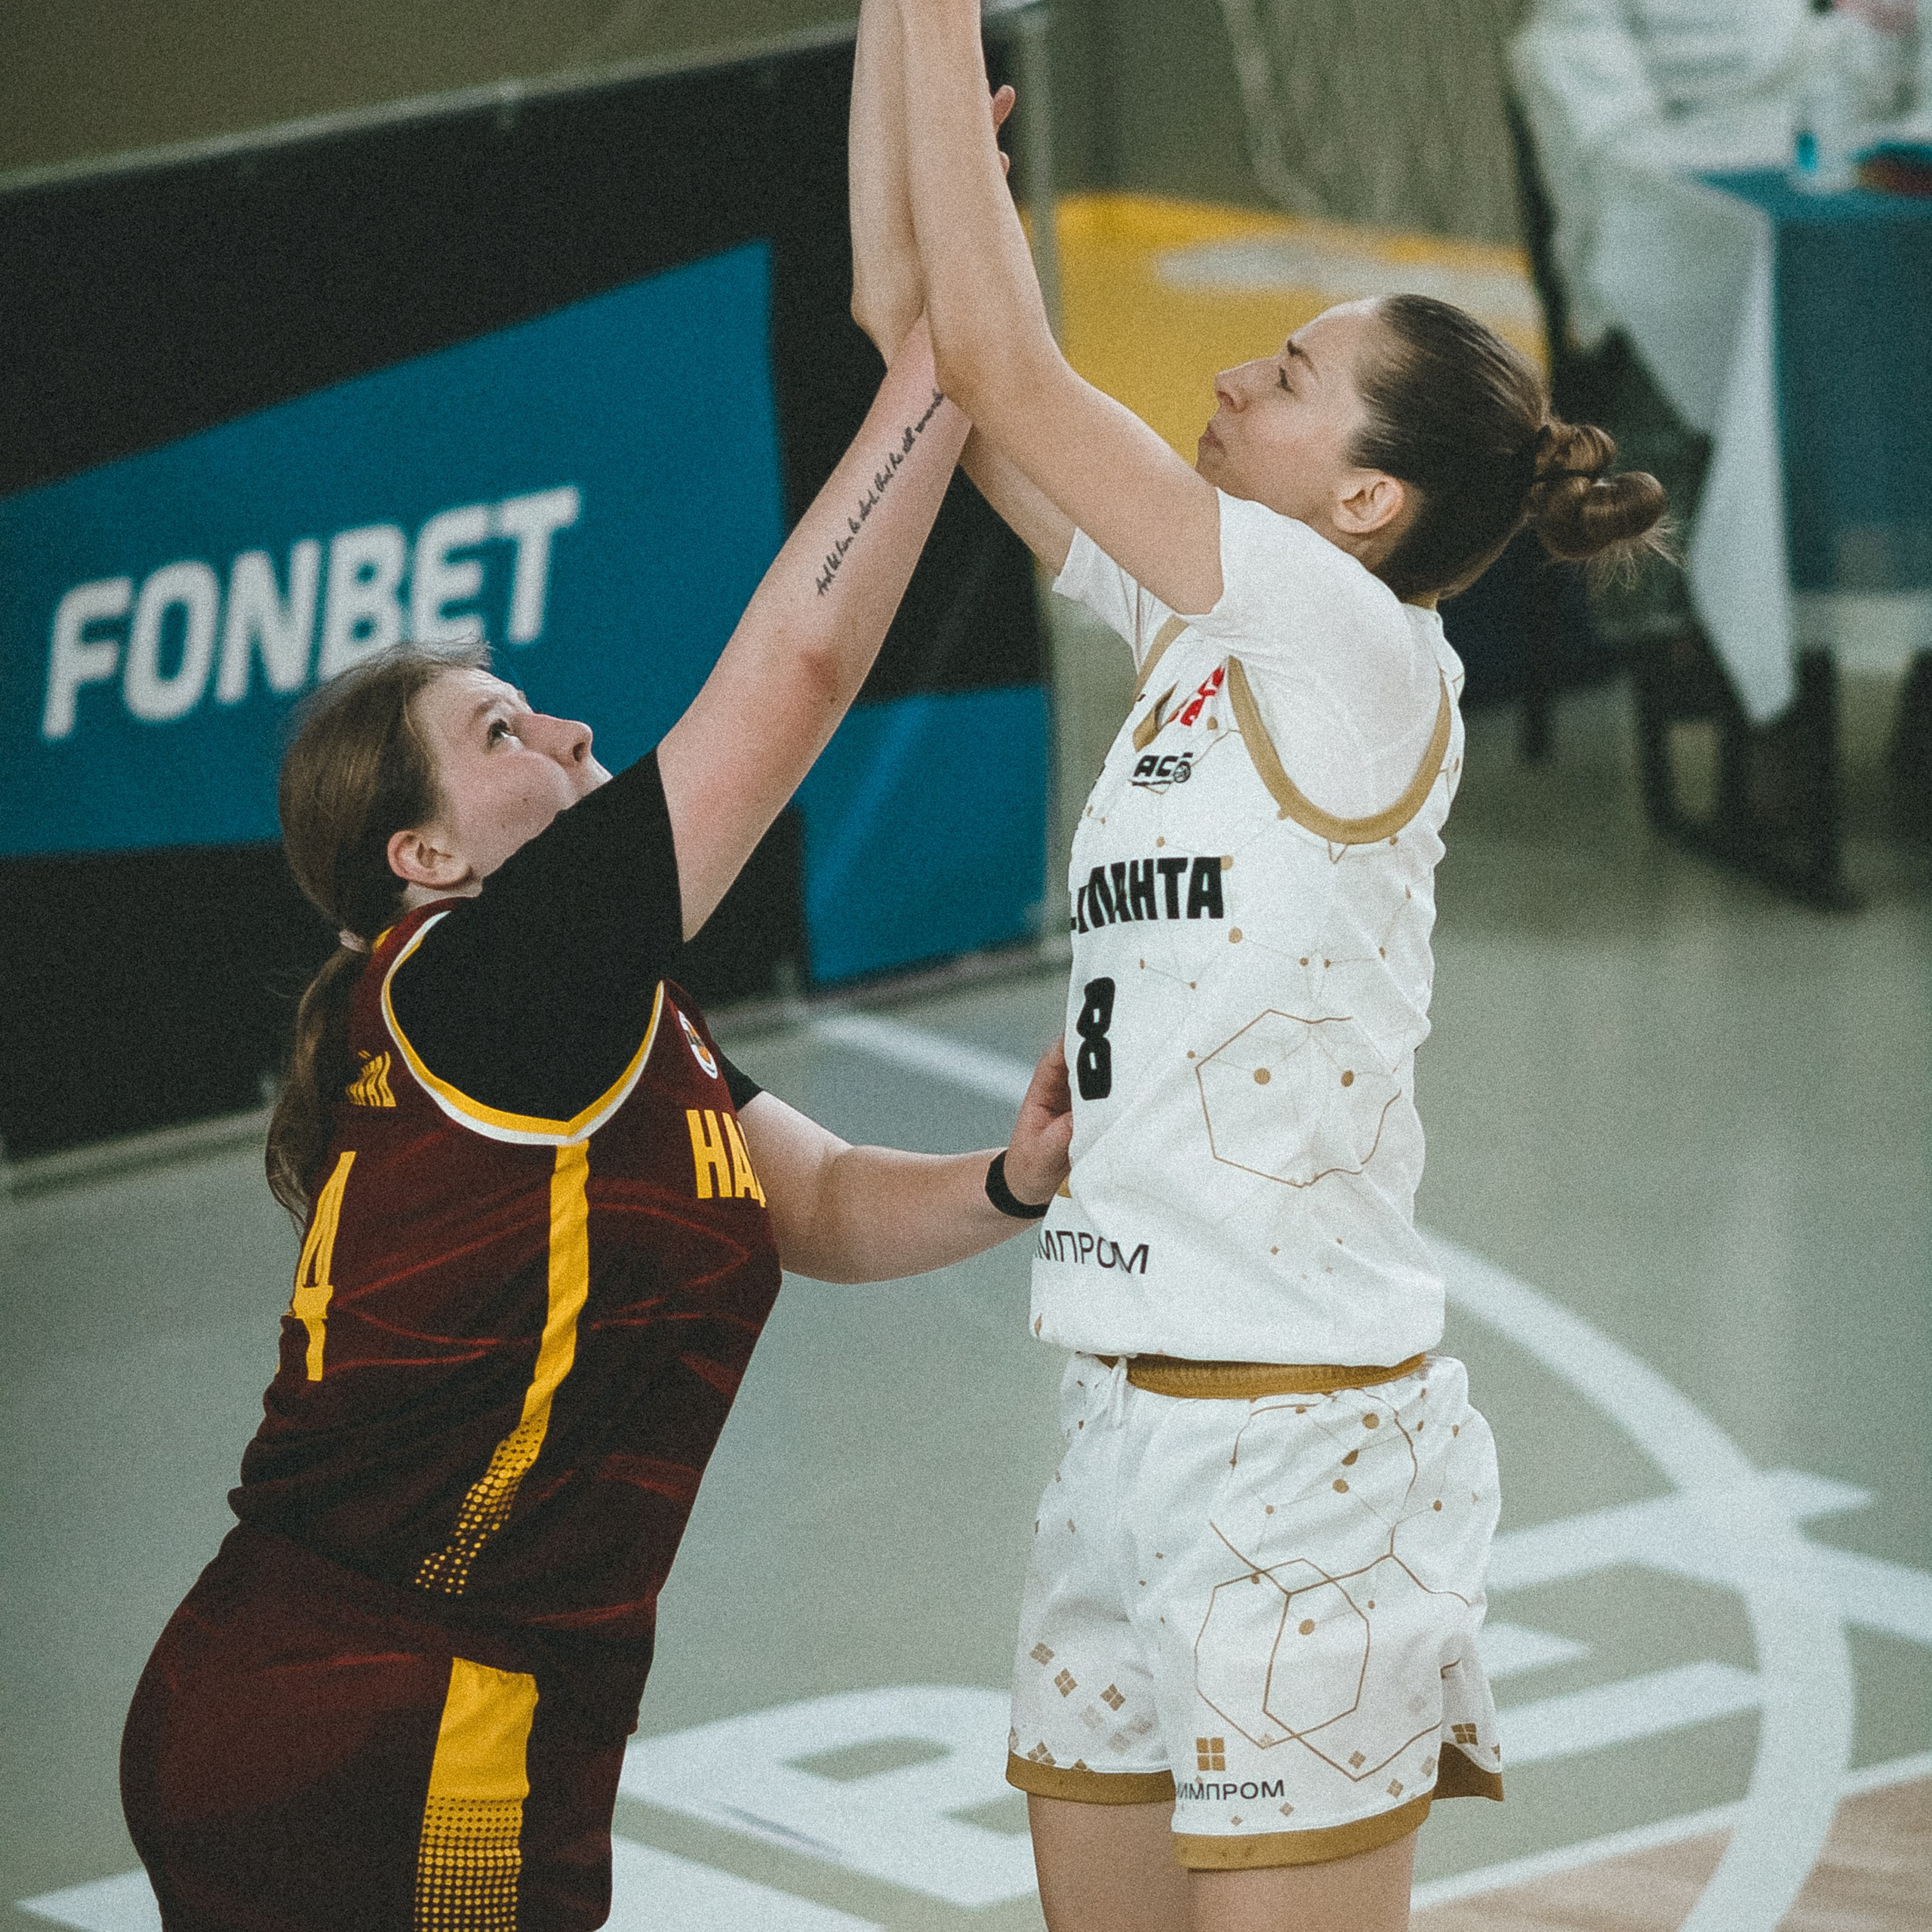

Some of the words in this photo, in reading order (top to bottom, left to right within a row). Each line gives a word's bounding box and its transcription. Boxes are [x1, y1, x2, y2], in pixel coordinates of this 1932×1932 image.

[42, 485, 580, 740] FONBET
[1076, 977, 1115, 1101] 8
[685, 1109, 766, 1208] НА
[294, 1151, 356, 1381] 4
[1035, 1229, 1149, 1275] МПРОМ
